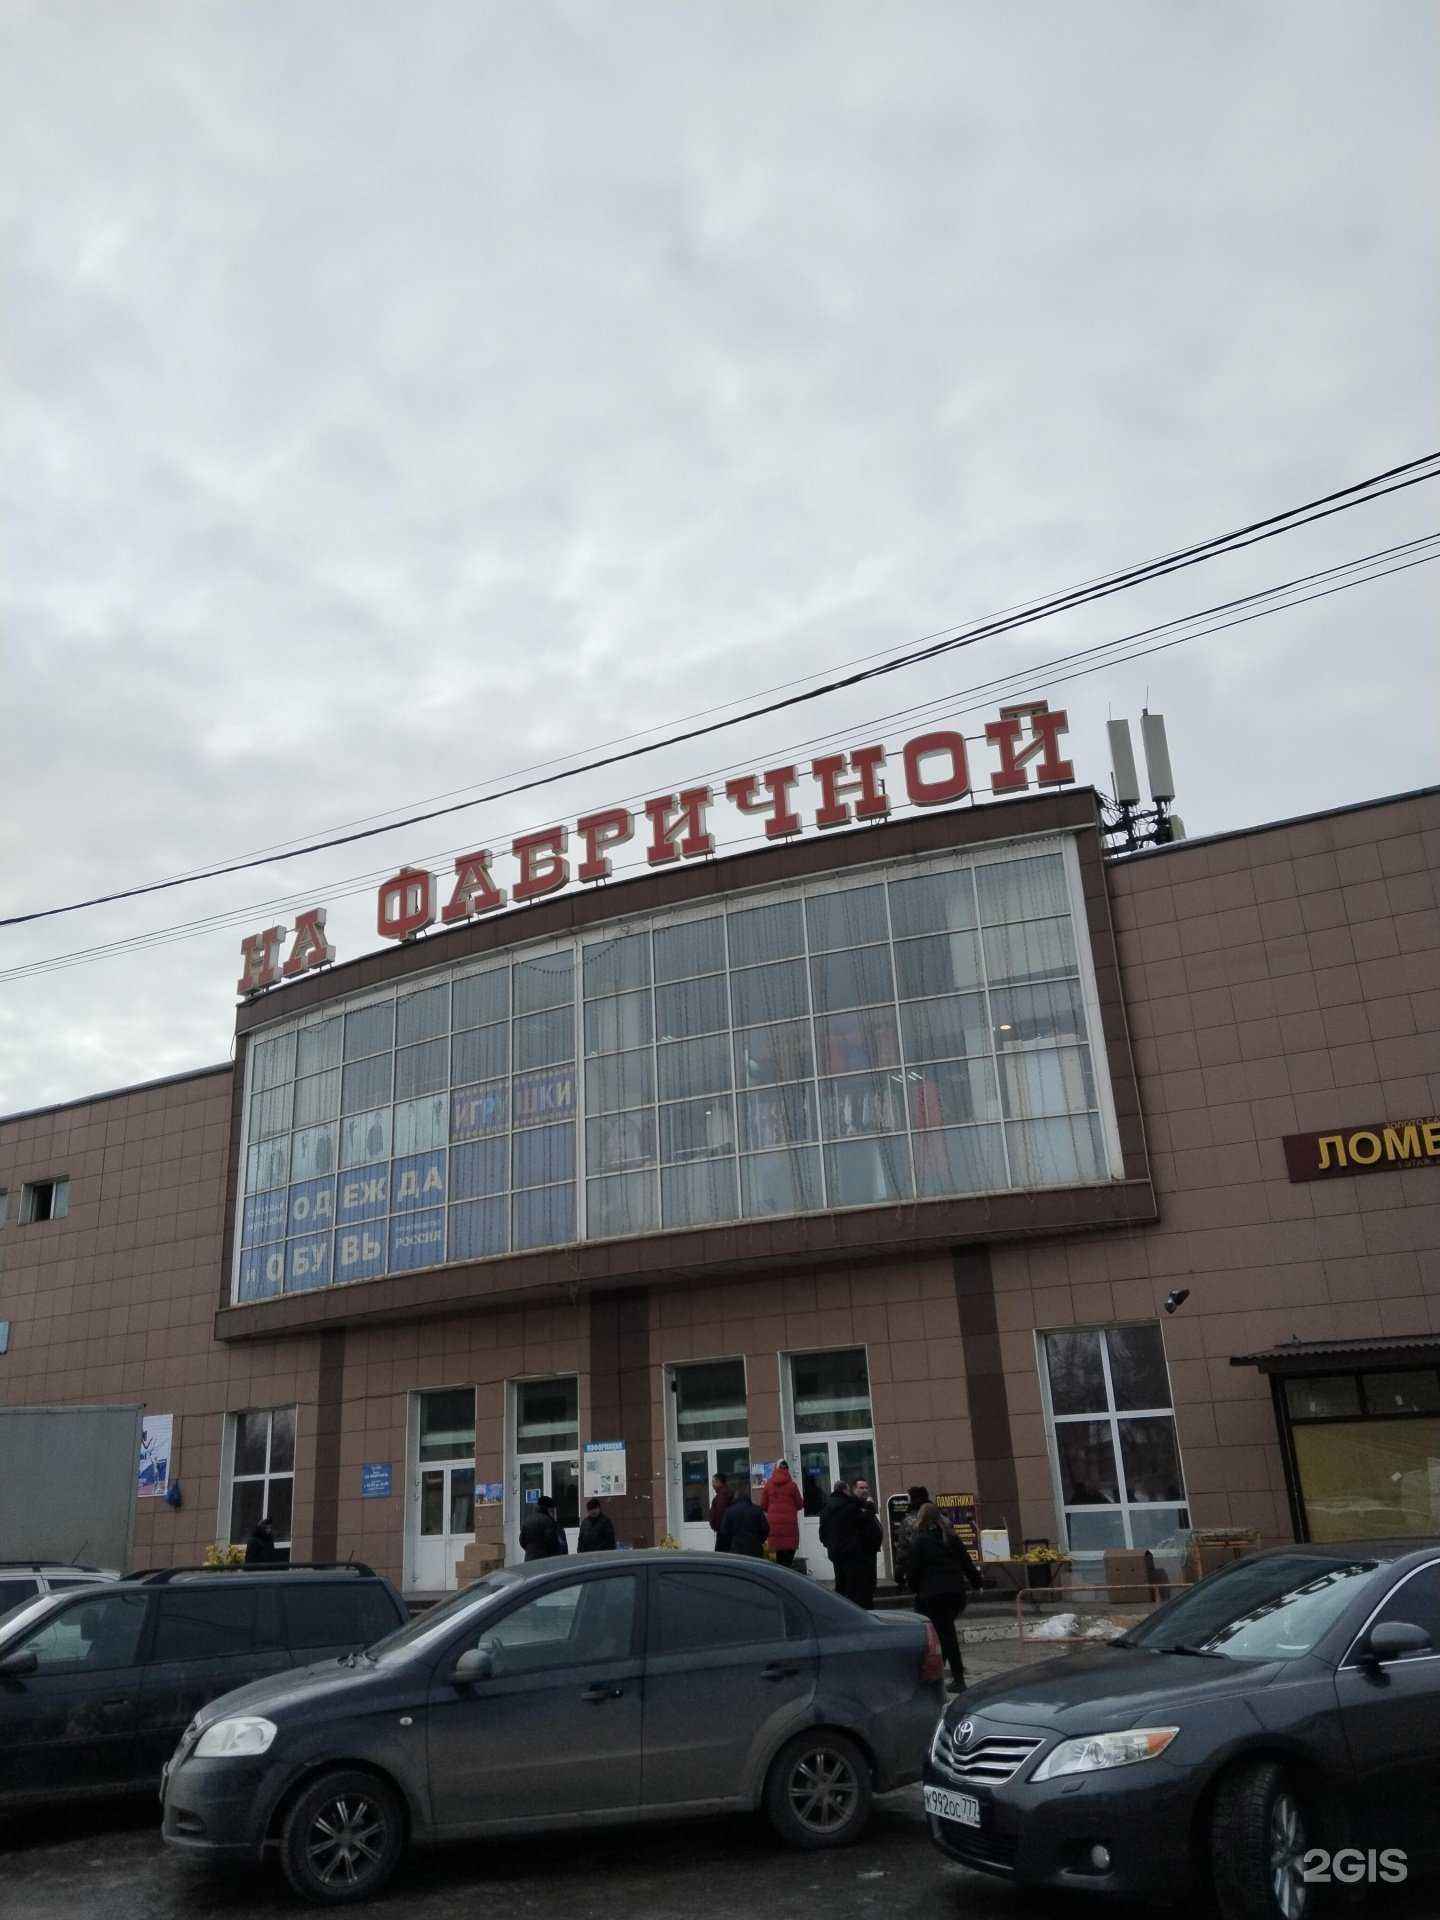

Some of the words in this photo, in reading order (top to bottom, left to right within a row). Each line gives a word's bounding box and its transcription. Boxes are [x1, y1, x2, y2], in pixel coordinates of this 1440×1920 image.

[237, 908, 336, 996] НА
[377, 699, 1075, 942] ФАБРИЧНОЙ
[293, 1166, 442, 1220] ОДЕЖДА
[266, 1232, 381, 1281] ОБУВЬ
